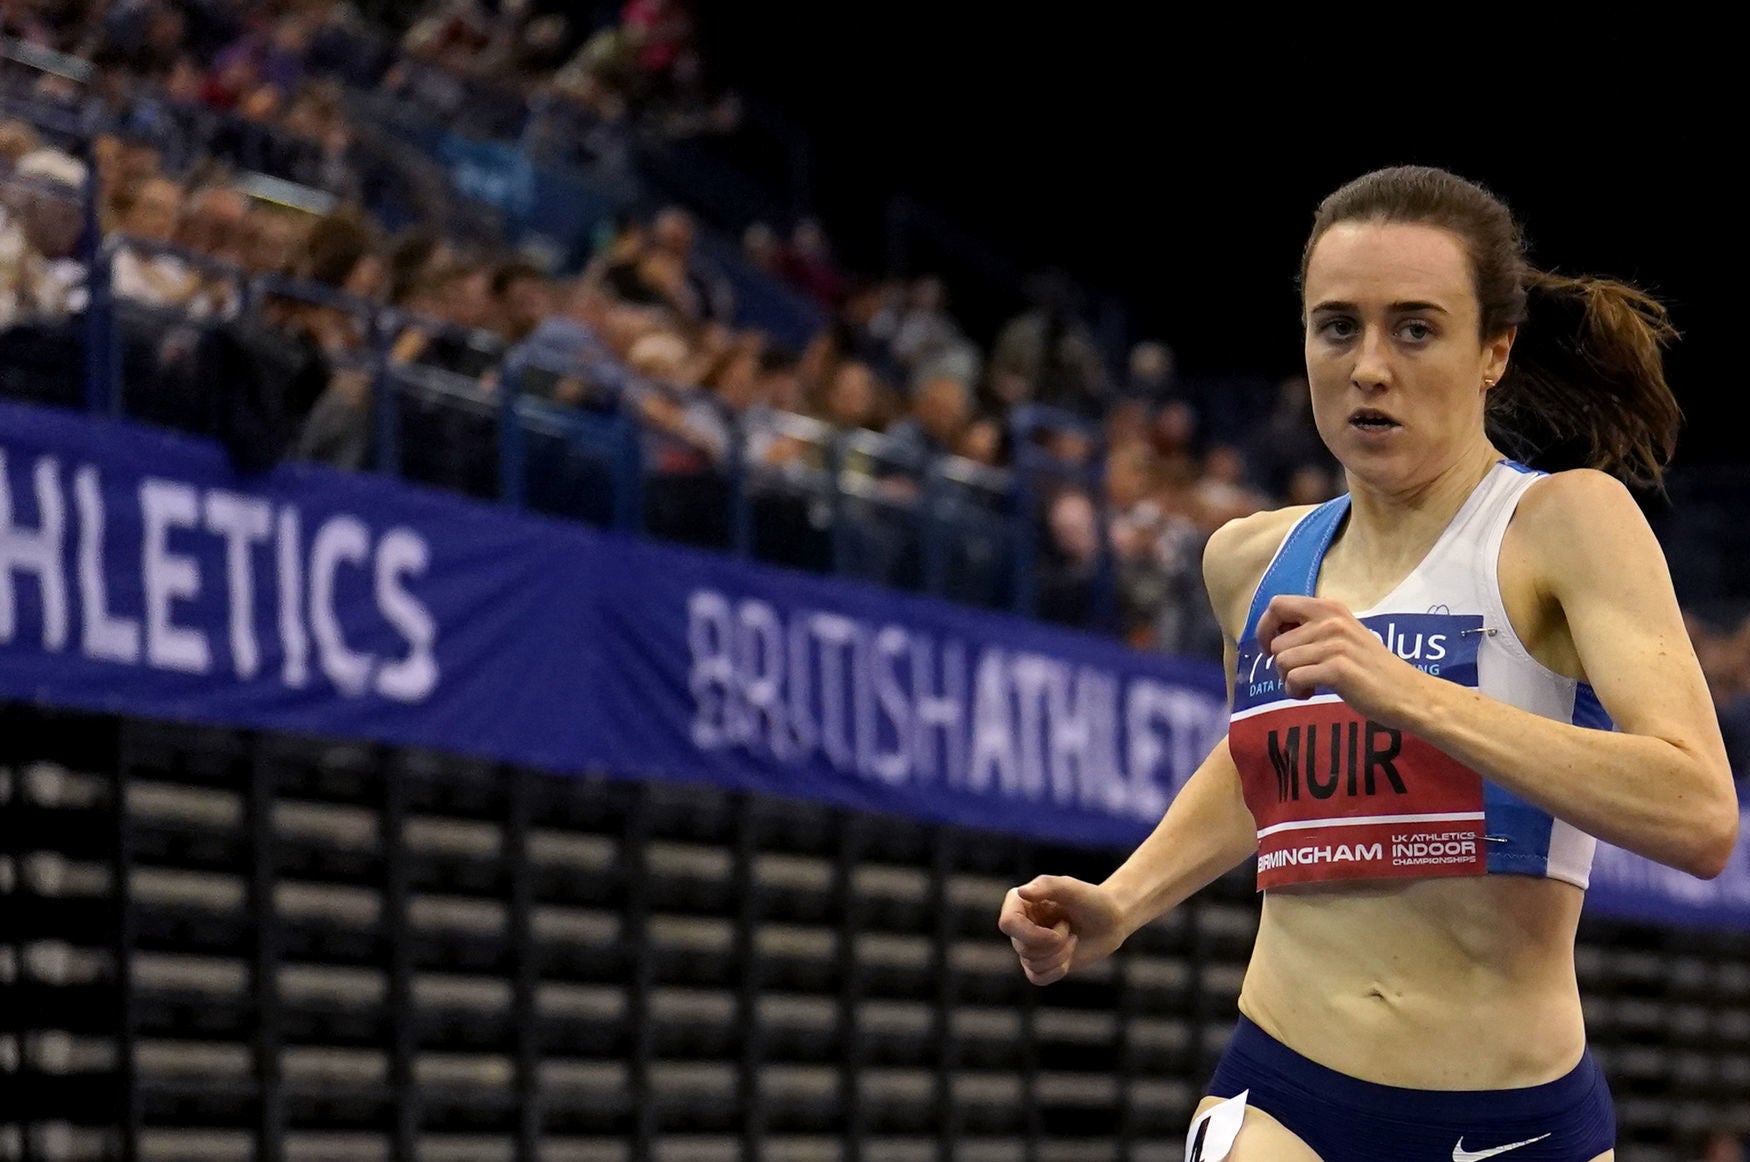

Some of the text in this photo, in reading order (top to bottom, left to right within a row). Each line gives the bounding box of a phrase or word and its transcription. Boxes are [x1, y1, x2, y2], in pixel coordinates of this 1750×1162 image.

[688, 588, 968, 790] BRITISH
[1268, 719, 1408, 803] MUIR
[1391, 831, 1476, 843] UK ATHLETICS
[1391, 841, 1476, 857] INDOOR
[1392, 855, 1476, 866] CHAMPIONSHIPS
